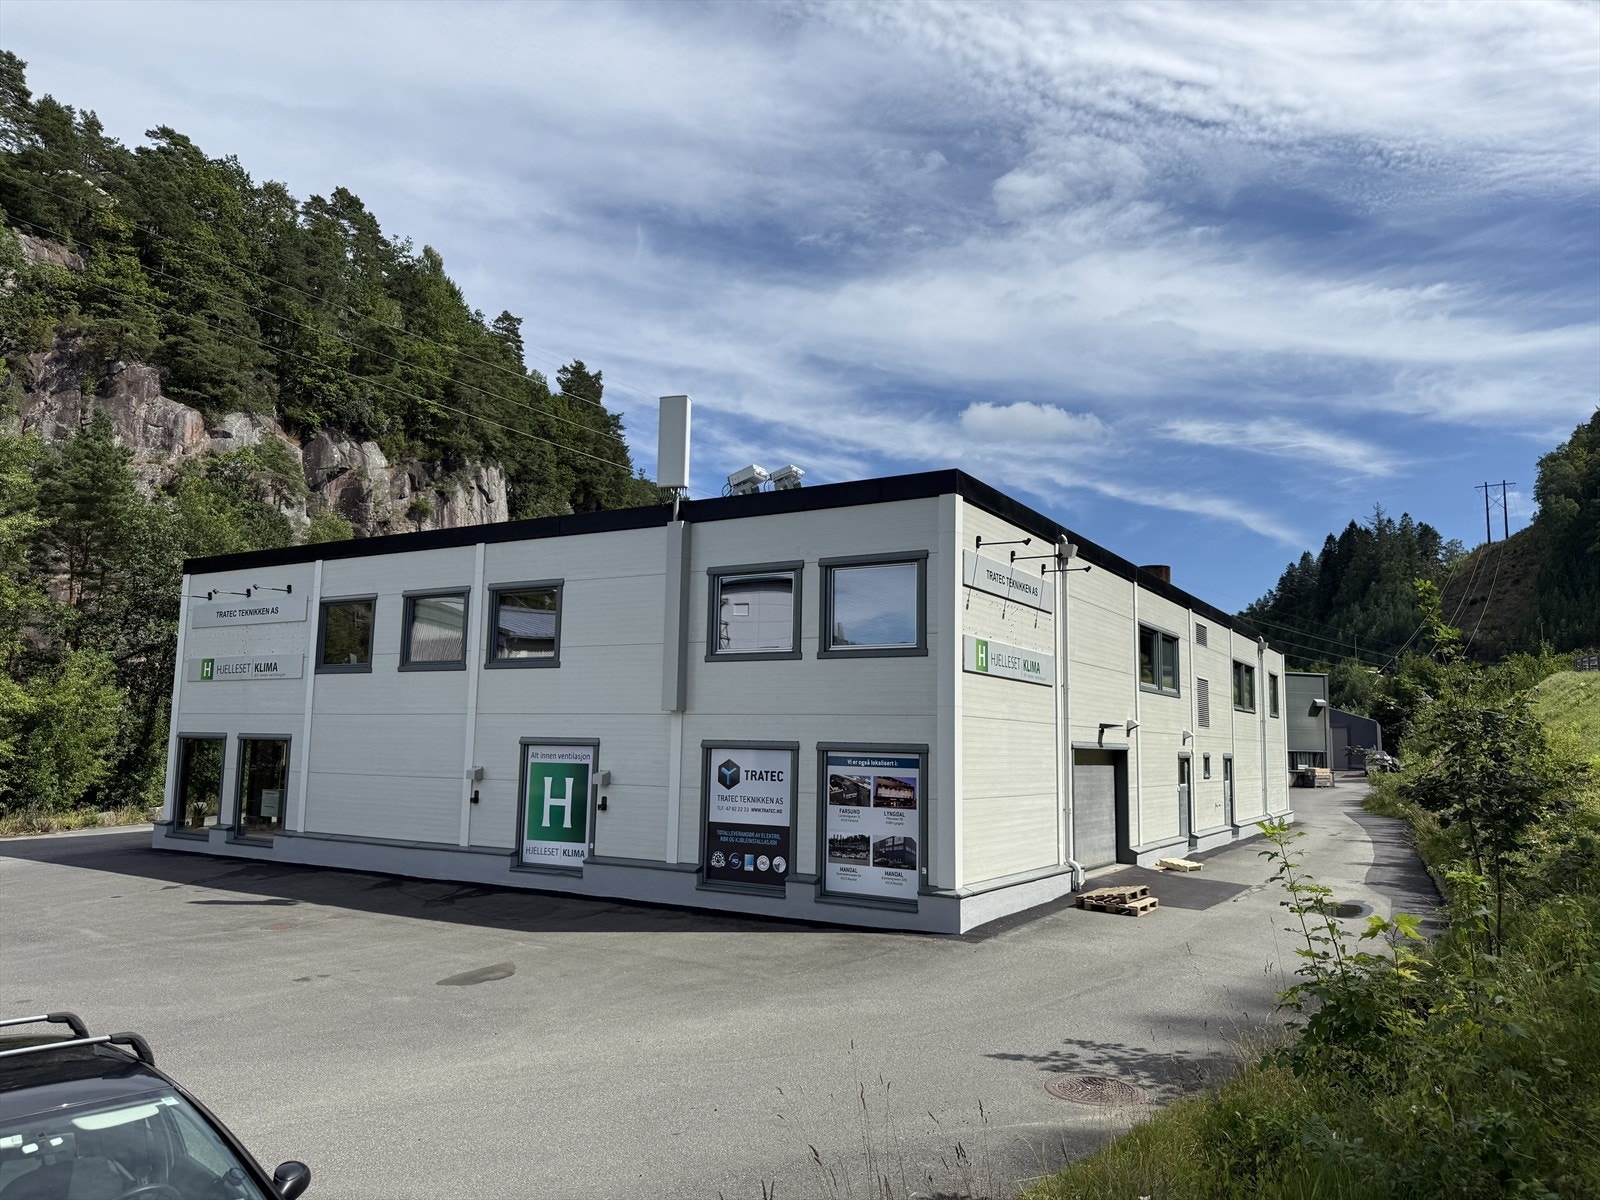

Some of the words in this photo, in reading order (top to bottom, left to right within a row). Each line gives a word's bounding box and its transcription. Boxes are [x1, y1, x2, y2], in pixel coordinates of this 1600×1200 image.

[986, 569, 1005, 585] TRATEC
[1006, 577, 1032, 594] TEKNIKKEN
[1032, 586, 1038, 597] AS
[216, 609, 237, 618] TRATEC
[238, 607, 270, 618] TEKNIKKEN
[270, 606, 279, 614] AS
[978, 645, 986, 667] H
[990, 652, 1021, 671] HJELLESET
[1023, 658, 1041, 675] KLIMA
[203, 662, 212, 677] H
[216, 662, 252, 674] HJELLESET
[254, 662, 278, 672] KLIMA
[540, 752, 556, 760] innen
[558, 752, 591, 762] ventilasjon
[744, 770, 784, 782] TRATEC
[542, 776, 574, 828] H
[717, 794, 738, 803] TRATEC
[740, 795, 774, 804] TEKNIKKEN
[775, 797, 784, 805] AS
[526, 846, 559, 857] HJELLESET
[562, 848, 585, 858] KLIMA
